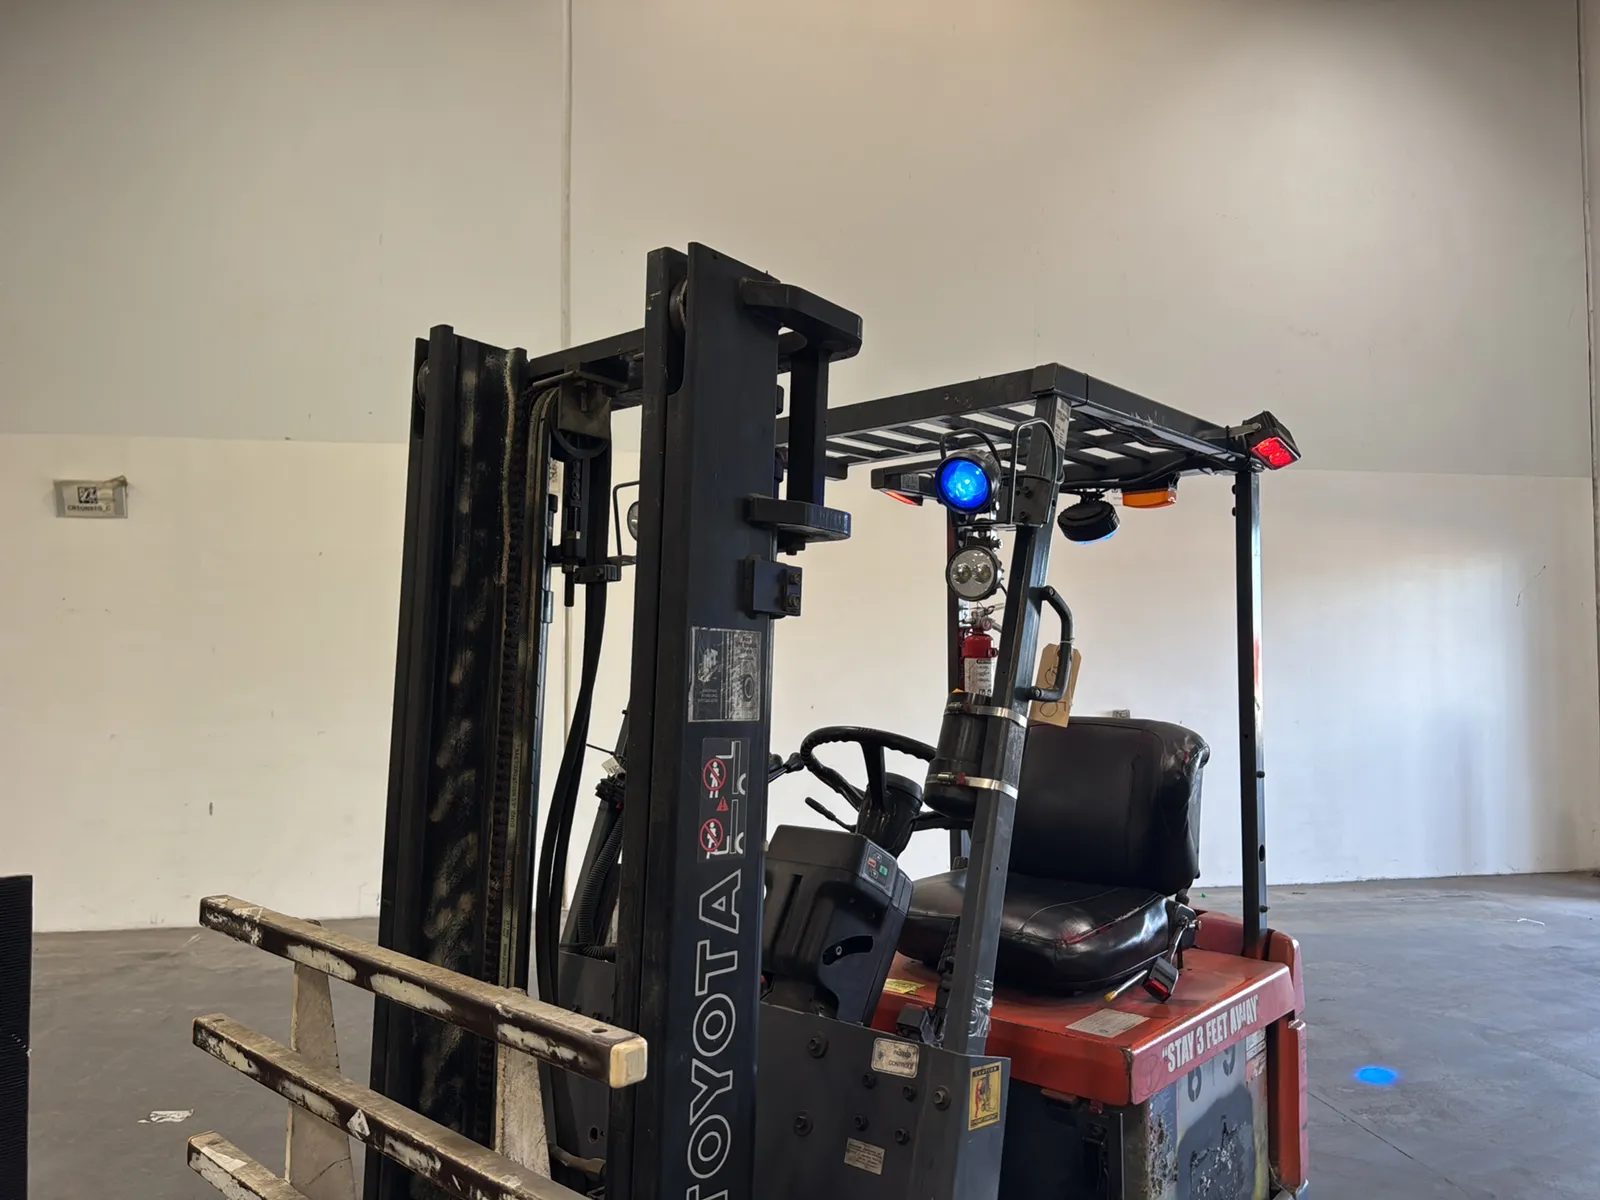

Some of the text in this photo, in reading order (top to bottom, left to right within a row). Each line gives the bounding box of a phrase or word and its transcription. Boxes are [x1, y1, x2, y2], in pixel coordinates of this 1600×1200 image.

[686, 869, 741, 1200] OYOTA
[1196, 1025, 1204, 1055] 3
[1206, 1011, 1229, 1050] FEET
